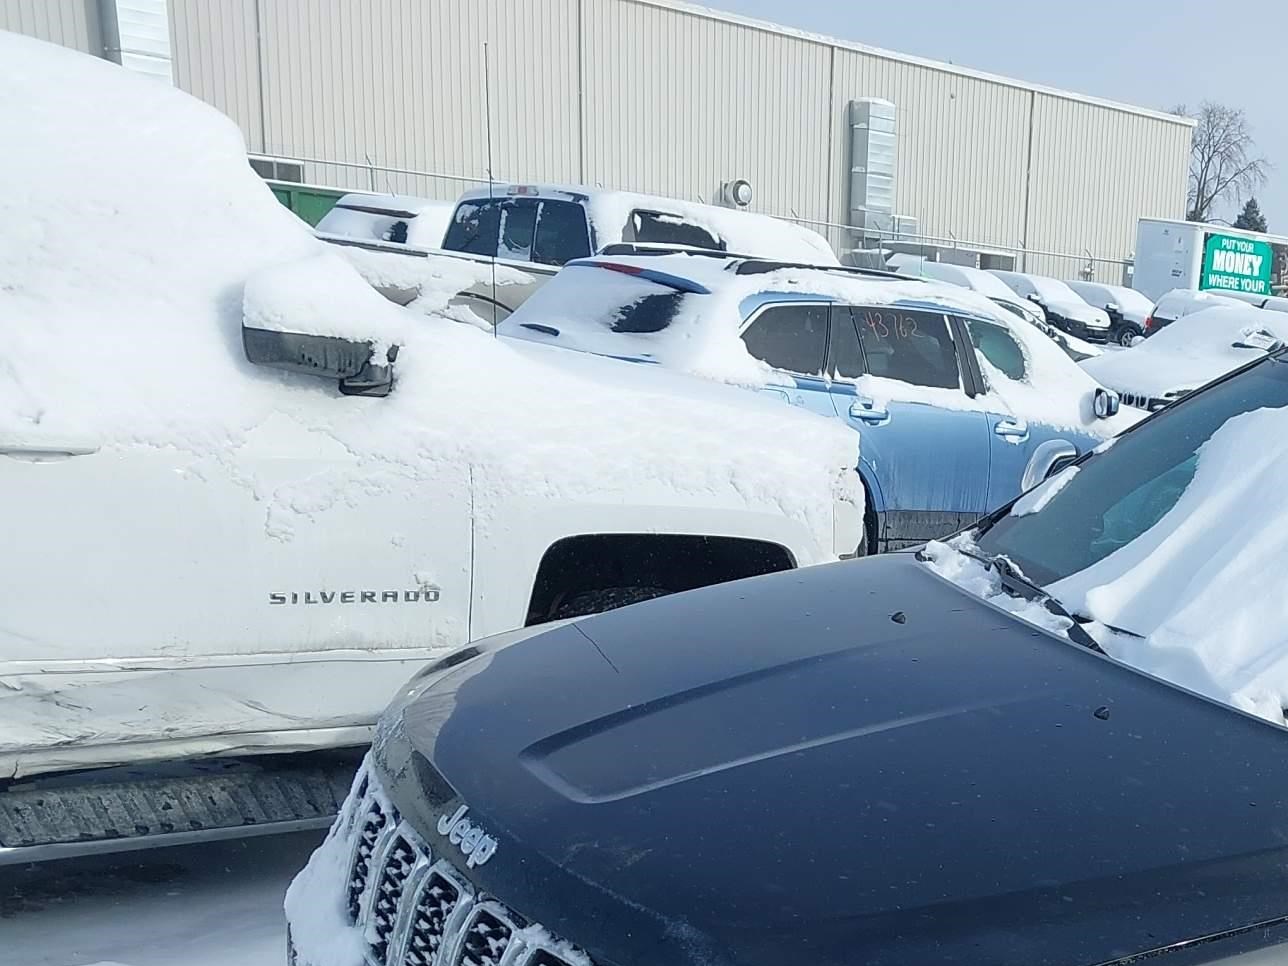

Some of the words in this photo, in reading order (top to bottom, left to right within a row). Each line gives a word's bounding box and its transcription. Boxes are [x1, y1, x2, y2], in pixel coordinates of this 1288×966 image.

[1221, 238, 1236, 249] PUT
[1236, 240, 1254, 253] YOUR
[1212, 249, 1263, 277] MONEY
[1208, 273, 1239, 290] WHERE
[1239, 278, 1265, 293] YOUR
[268, 590, 440, 605] SILVERADO
[437, 804, 498, 869] Jeep
